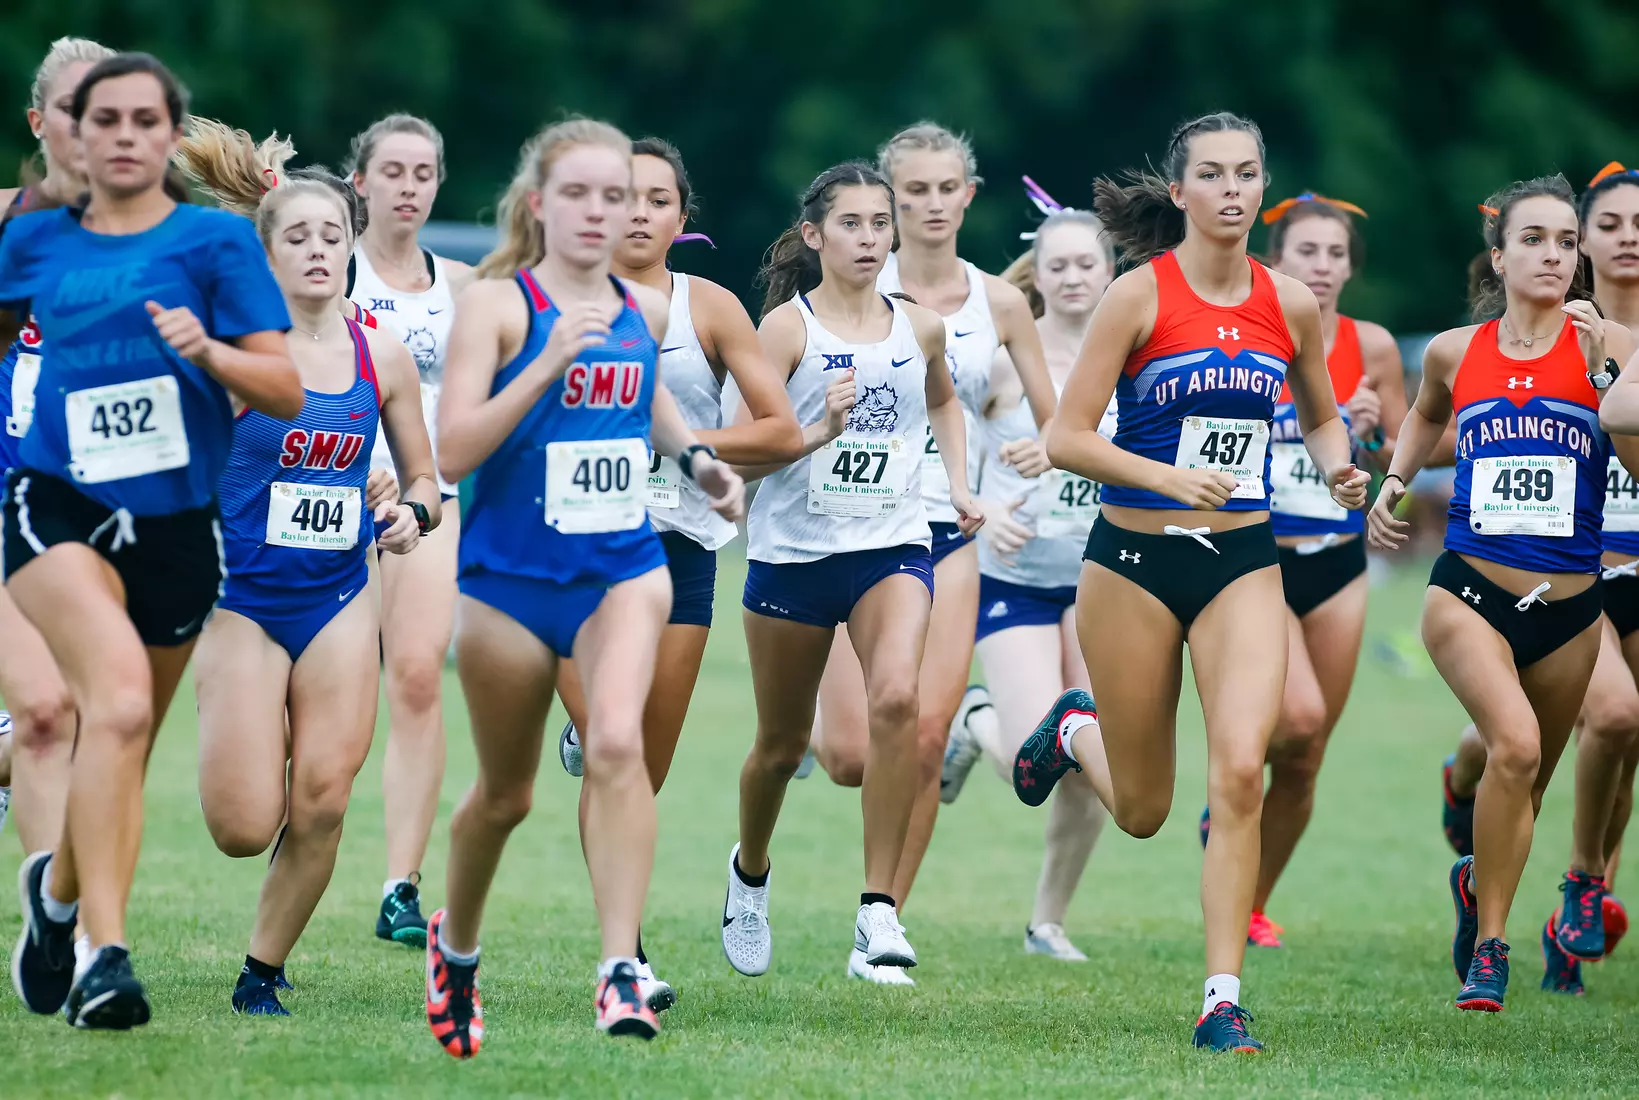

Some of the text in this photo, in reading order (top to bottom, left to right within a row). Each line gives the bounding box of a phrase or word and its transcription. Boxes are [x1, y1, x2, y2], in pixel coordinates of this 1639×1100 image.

[369, 297, 398, 312] XII
[821, 353, 857, 372] XII
[560, 361, 645, 409] SMU
[1155, 366, 1284, 406] UT ARLINGTO
[91, 397, 157, 440] 432
[1206, 421, 1232, 431] Baylor
[1234, 422, 1254, 431] Invite
[279, 429, 366, 472] SMU
[835, 440, 863, 450] Baylor
[866, 441, 889, 450] Invite
[1199, 431, 1253, 465] 437
[1480, 416, 1592, 460] ARLINGTON
[572, 456, 631, 493] 400
[832, 450, 889, 484] 427
[1290, 457, 1328, 486] 44
[1495, 458, 1525, 469] Baylor
[1527, 458, 1554, 468] Invite
[296, 487, 346, 499] Baylor Invite
[823, 483, 894, 496] Baylor University
[1492, 468, 1554, 502] 439
[1606, 469, 1639, 499] 44
[290, 498, 344, 533] 404
[1483, 502, 1561, 514] Baylor University
[280, 531, 348, 545] Baylor University
